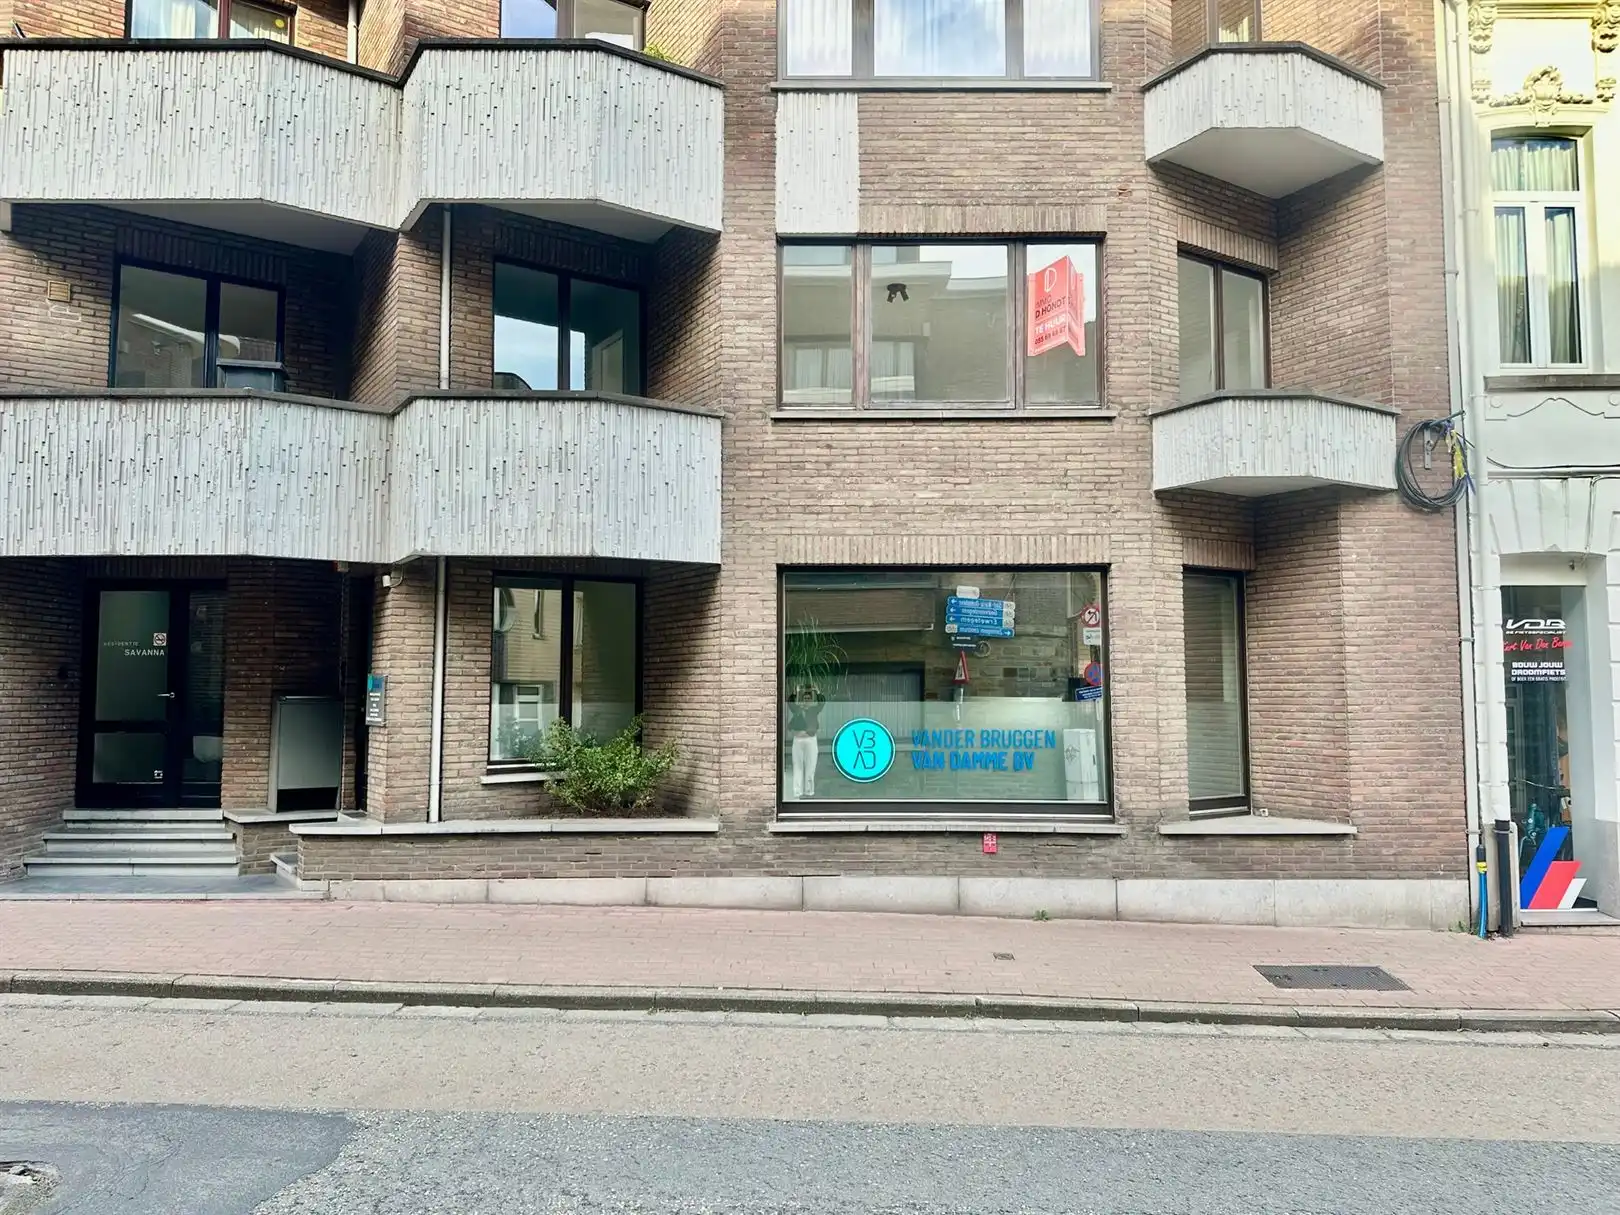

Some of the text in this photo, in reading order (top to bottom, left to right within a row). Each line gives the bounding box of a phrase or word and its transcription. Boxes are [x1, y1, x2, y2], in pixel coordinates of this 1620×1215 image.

[1506, 619, 1566, 629] VDB
[980, 729, 1056, 748] BRUGGEN
[912, 751, 1036, 770] VAN DAMME BV
